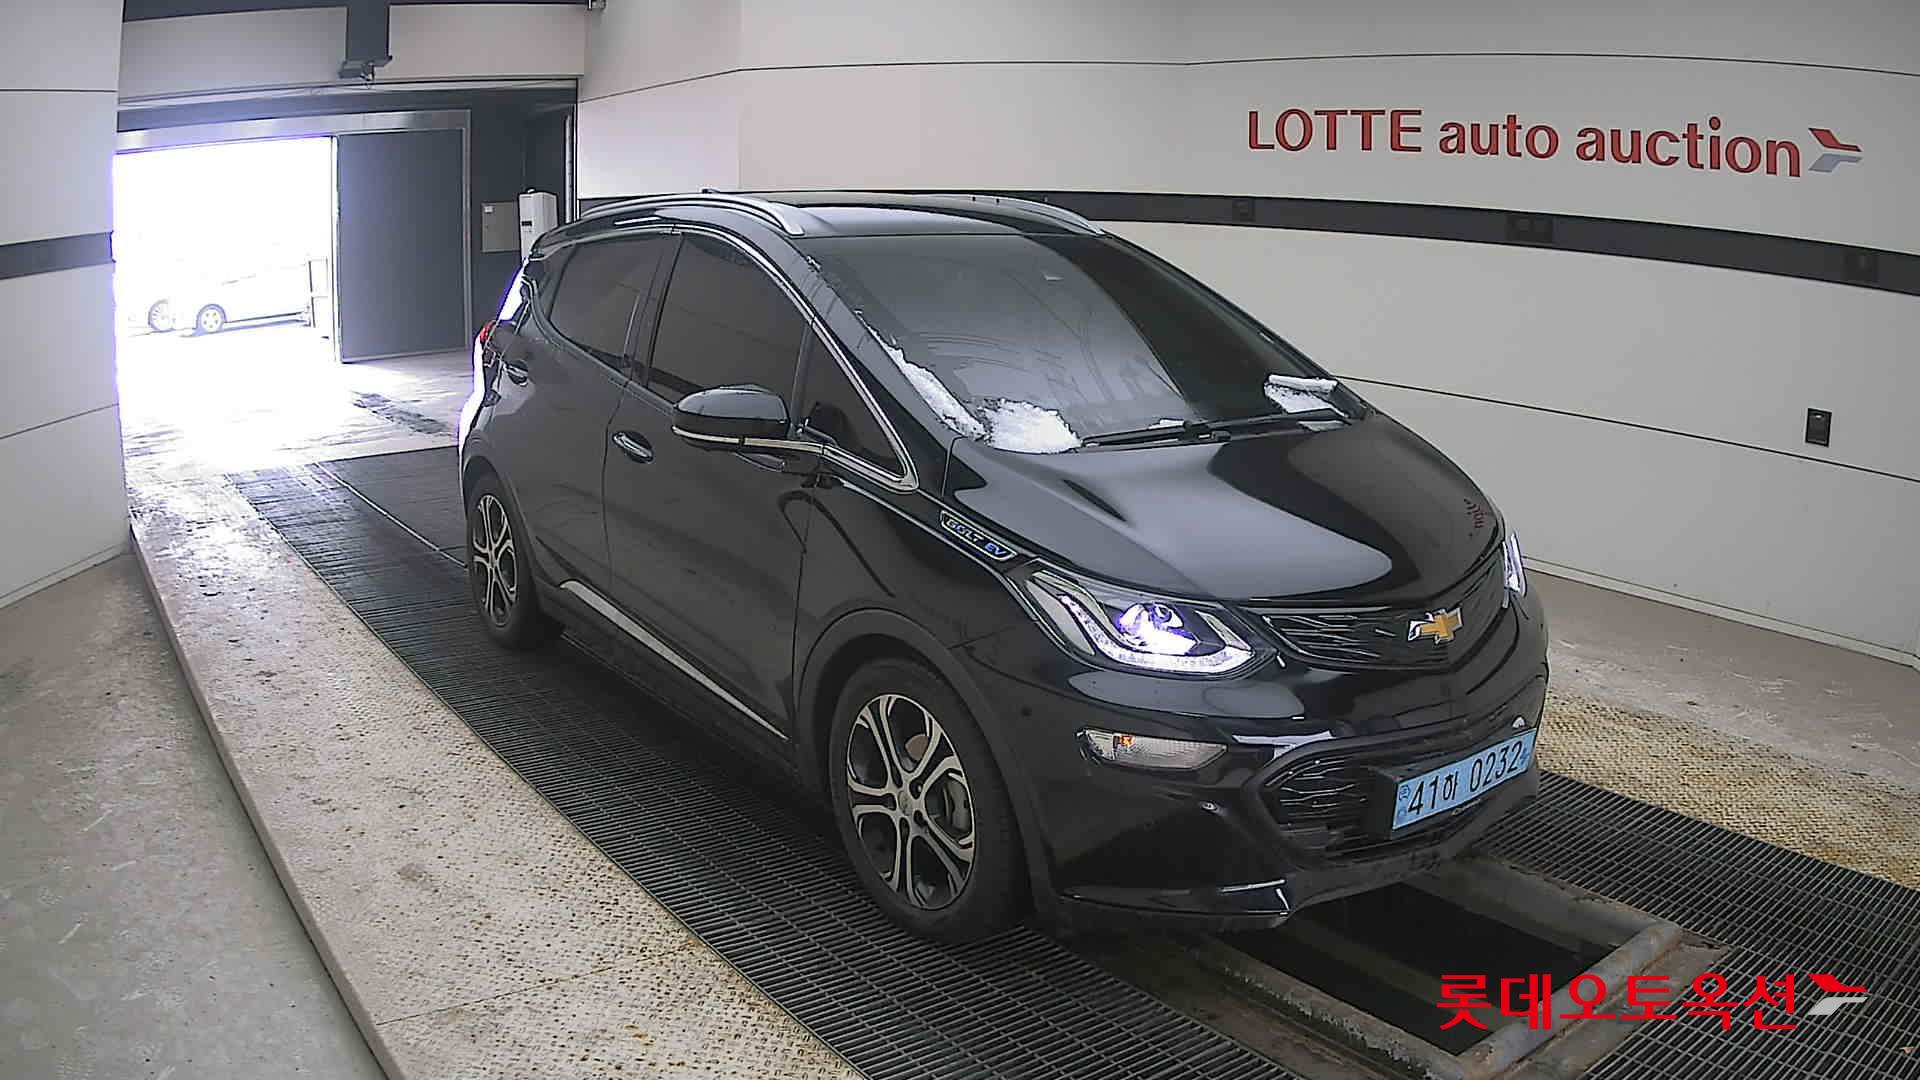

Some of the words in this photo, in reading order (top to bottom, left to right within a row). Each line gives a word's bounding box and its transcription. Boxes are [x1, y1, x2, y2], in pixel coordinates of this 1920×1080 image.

[1248, 108, 1423, 153] LOTTE
[1439, 114, 1560, 161] auto
[1575, 116, 1802, 178] auction
[946, 518, 984, 542] BOLT
[984, 542, 1007, 555] EV
[1408, 771, 1459, 815] 41하
[1469, 740, 1524, 793] 0232
